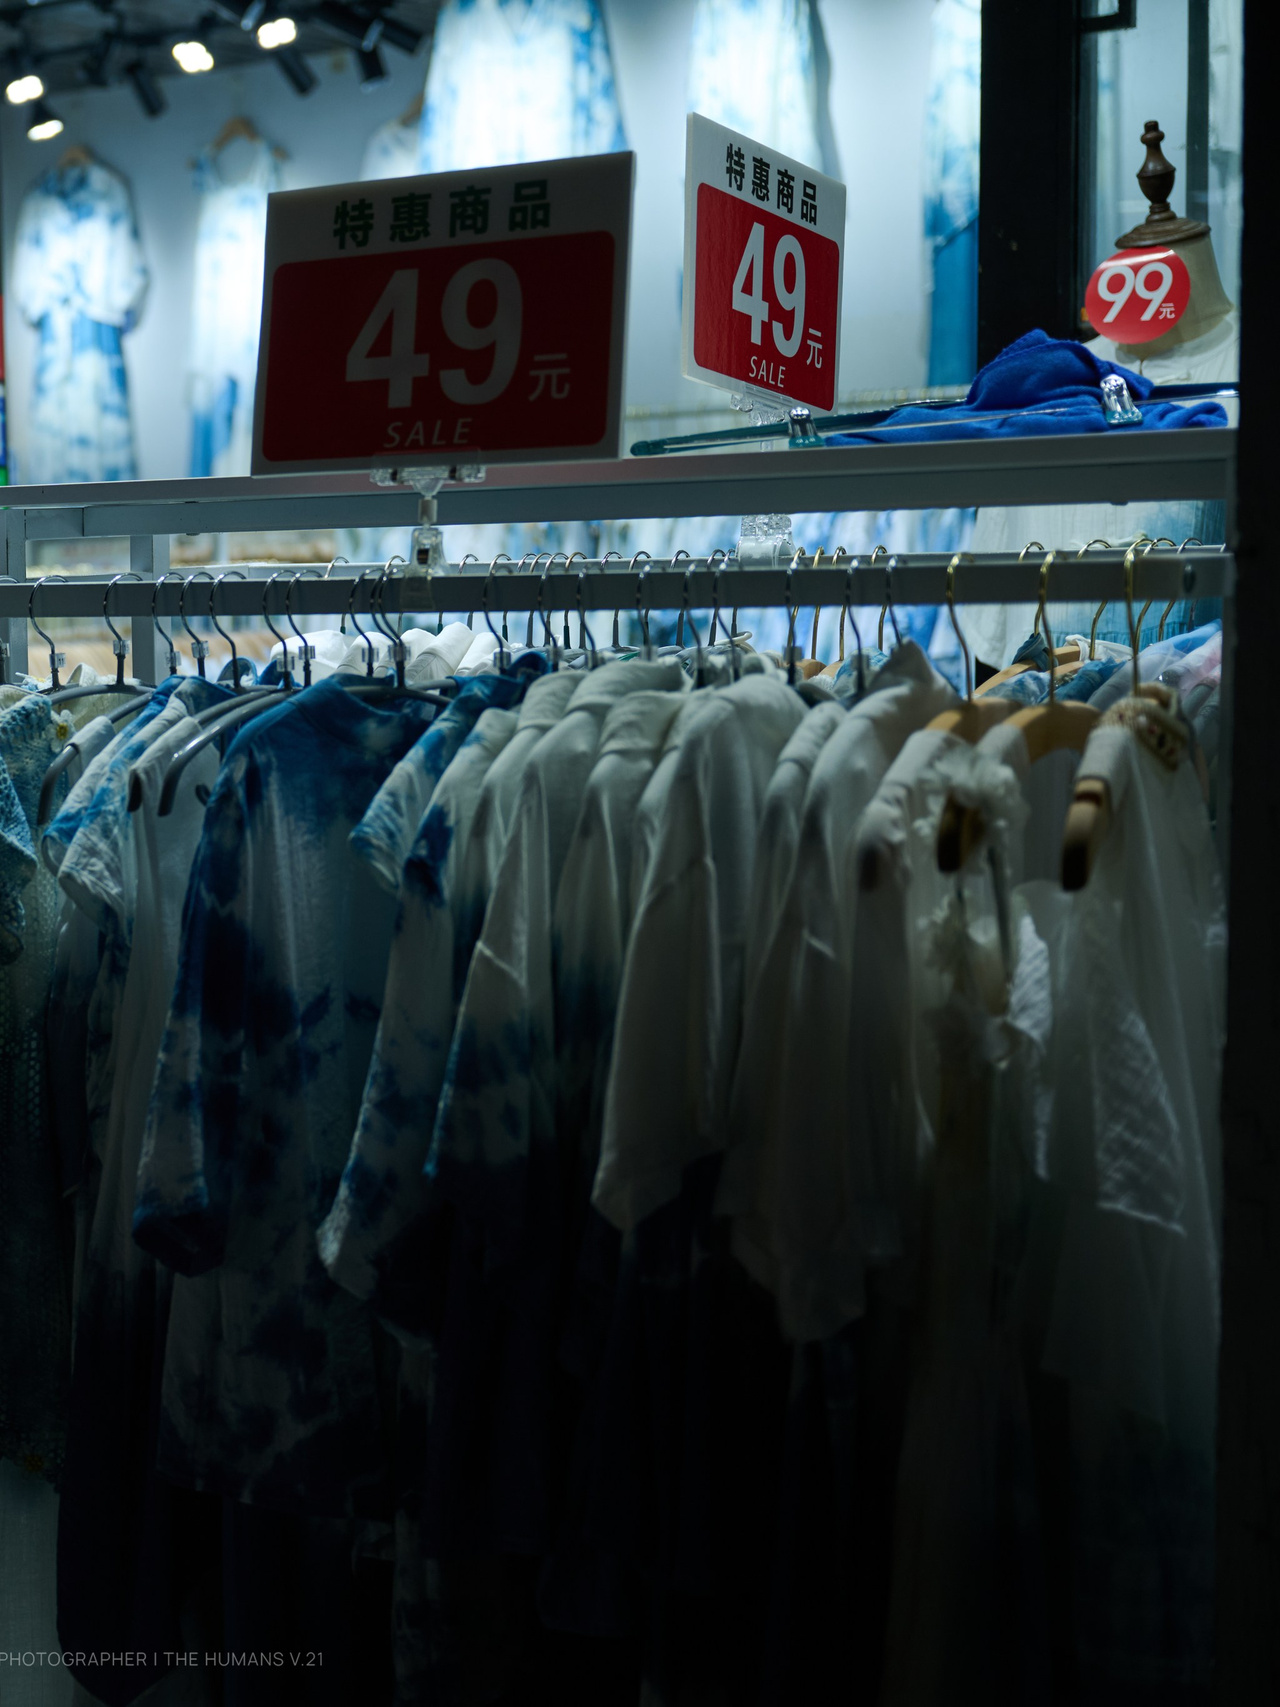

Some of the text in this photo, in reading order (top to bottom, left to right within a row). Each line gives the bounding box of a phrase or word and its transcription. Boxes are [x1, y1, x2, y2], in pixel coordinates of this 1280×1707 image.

[726, 143, 818, 226] 特惠商品
[333, 179, 551, 250] 特惠商品
[749, 355, 786, 388] SALE
[383, 417, 473, 449] SALE
